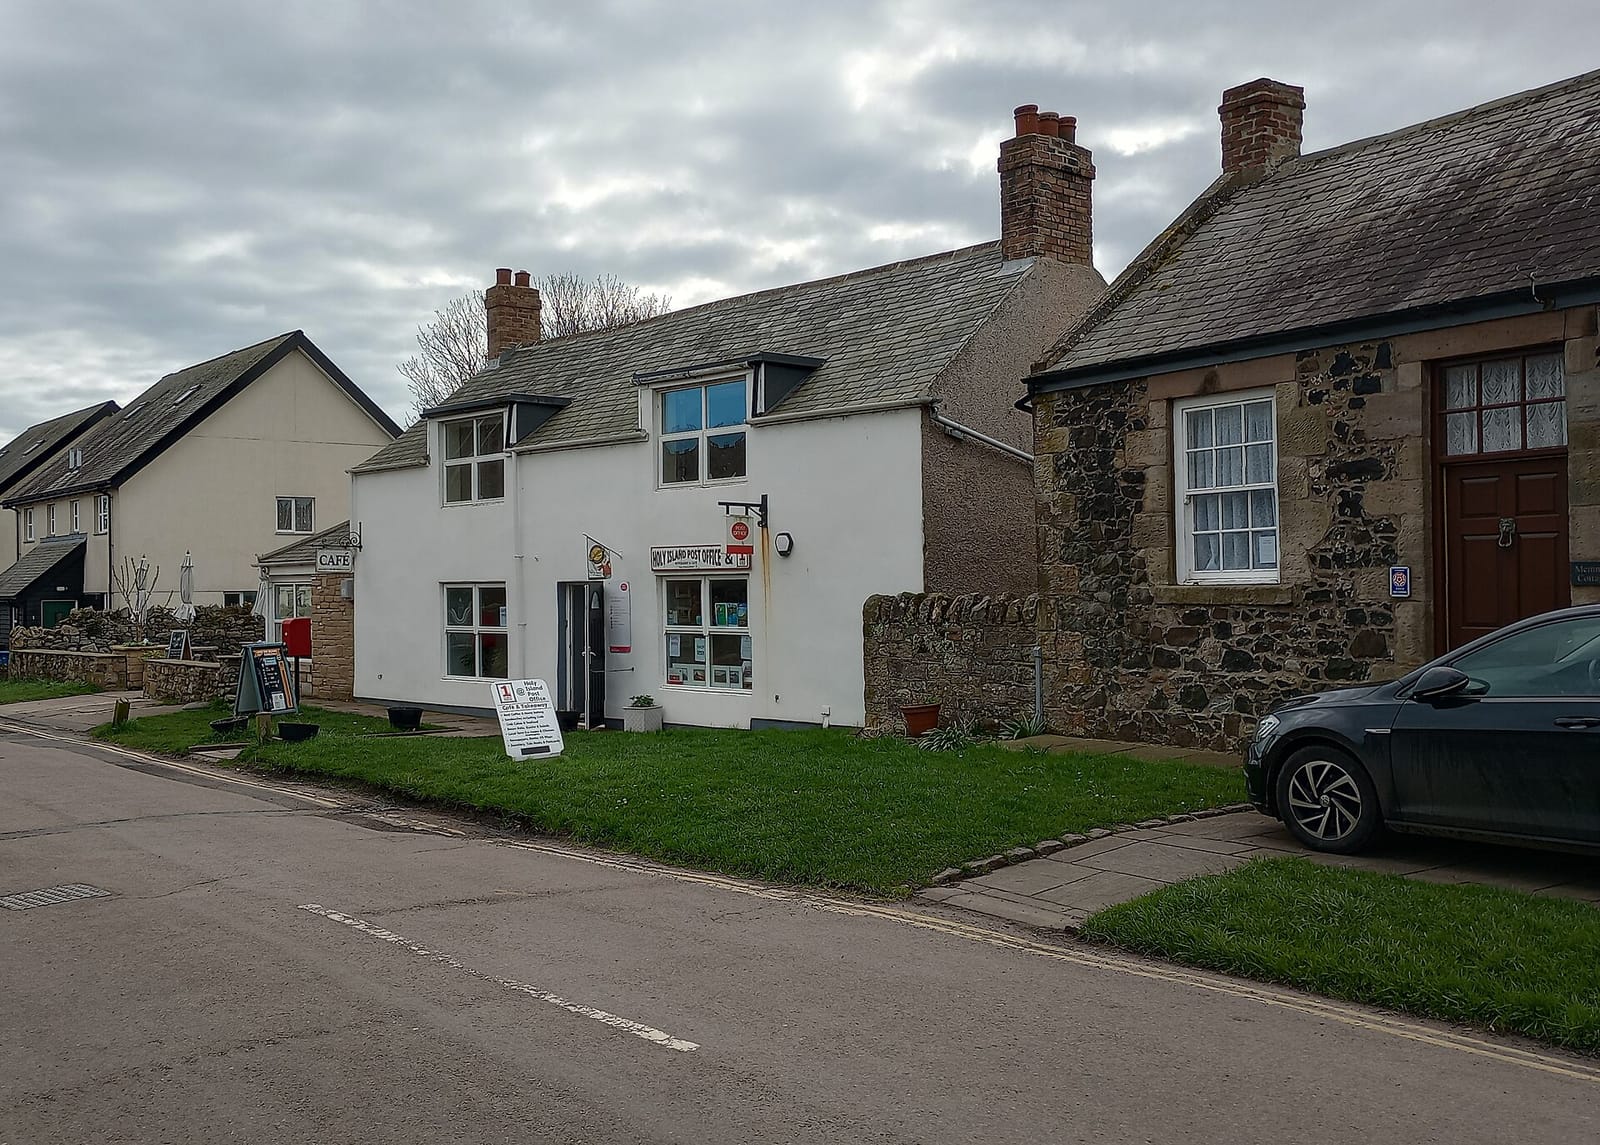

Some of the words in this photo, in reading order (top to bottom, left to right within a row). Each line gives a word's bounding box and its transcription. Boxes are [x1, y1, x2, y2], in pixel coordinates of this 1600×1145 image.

[320, 552, 350, 566] CAFÉ
[652, 549, 667, 567] HOLY
[667, 548, 686, 564] ISLAND
[687, 548, 701, 561] POST
[701, 548, 721, 566] OFFICE
[725, 553, 733, 564] &
[501, 685, 511, 697] 1
